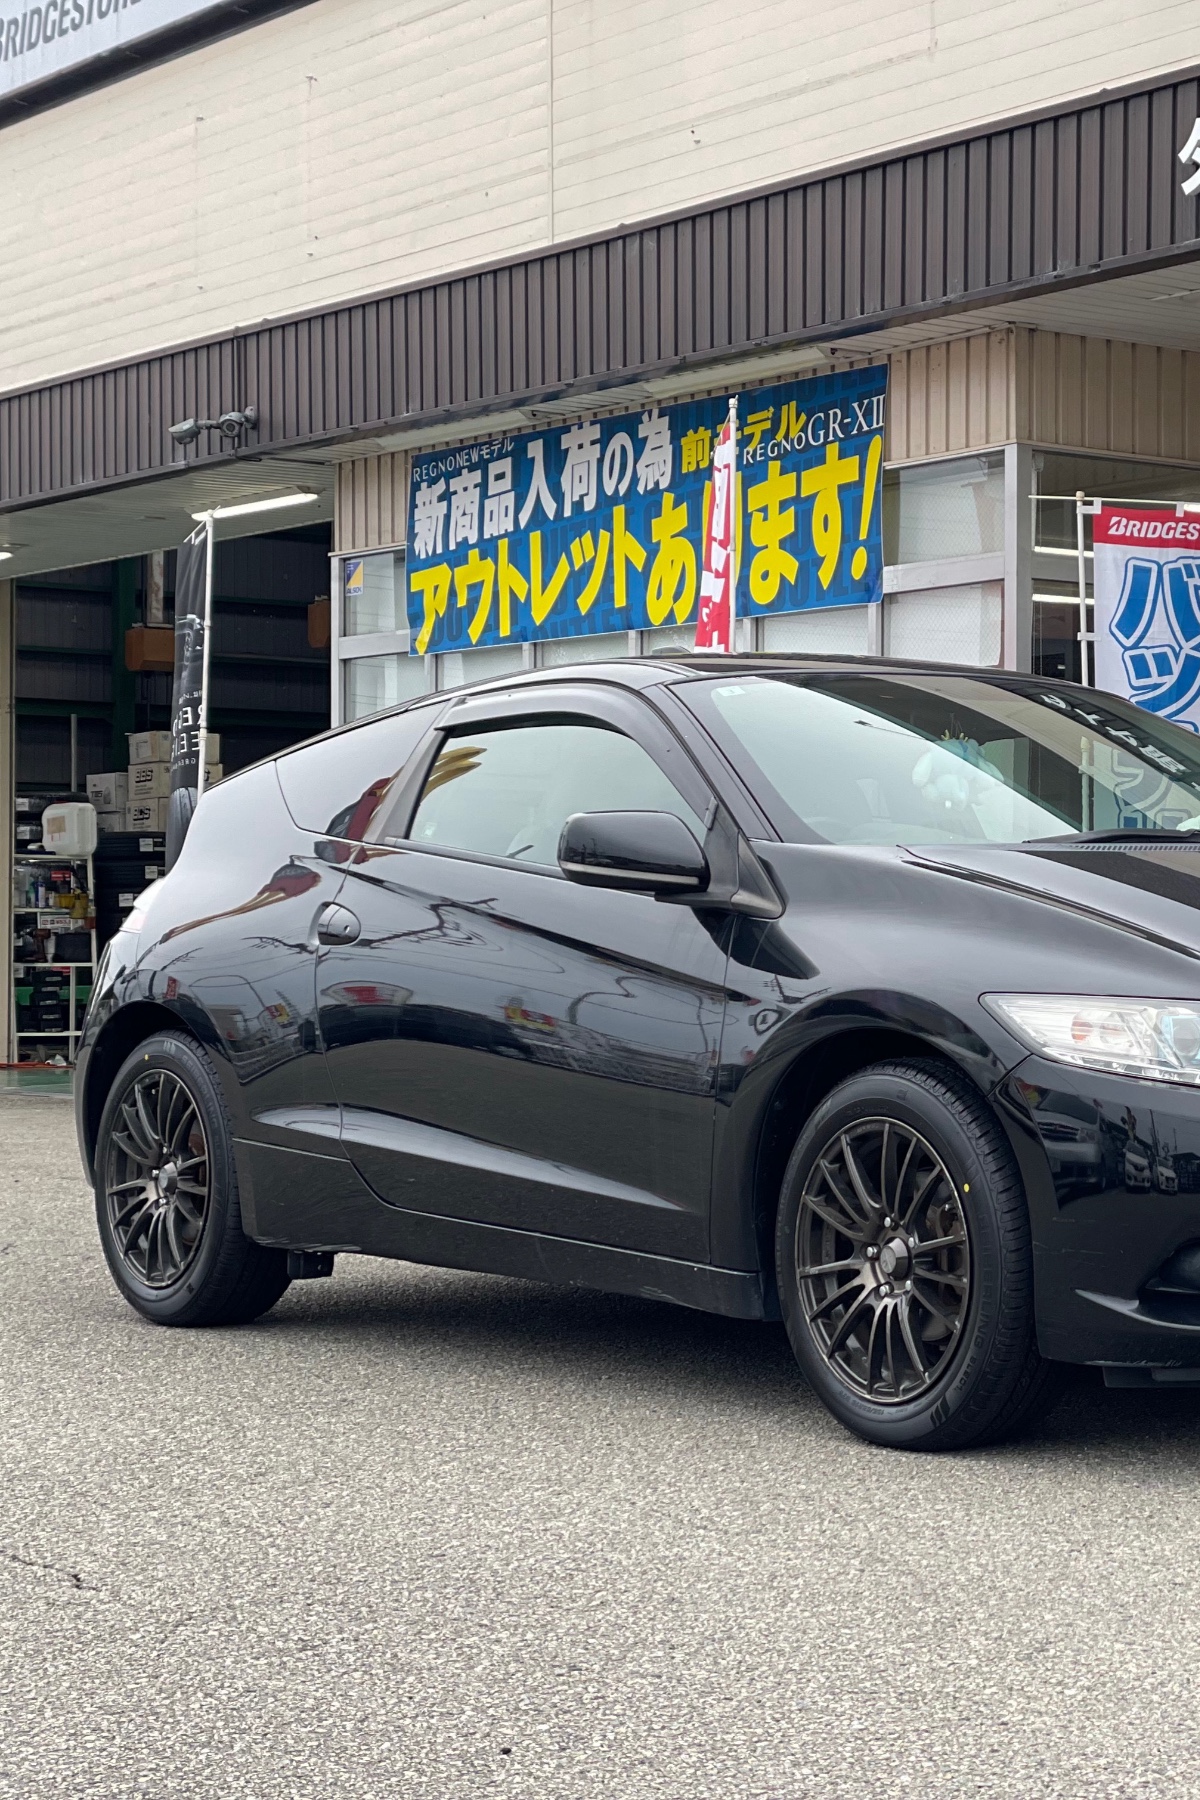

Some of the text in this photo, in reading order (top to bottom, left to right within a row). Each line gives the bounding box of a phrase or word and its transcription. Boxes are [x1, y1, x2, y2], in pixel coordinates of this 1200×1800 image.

[0, 0, 140, 61] RIDGESTO
[414, 408, 673, 559] 新商品入荷の為
